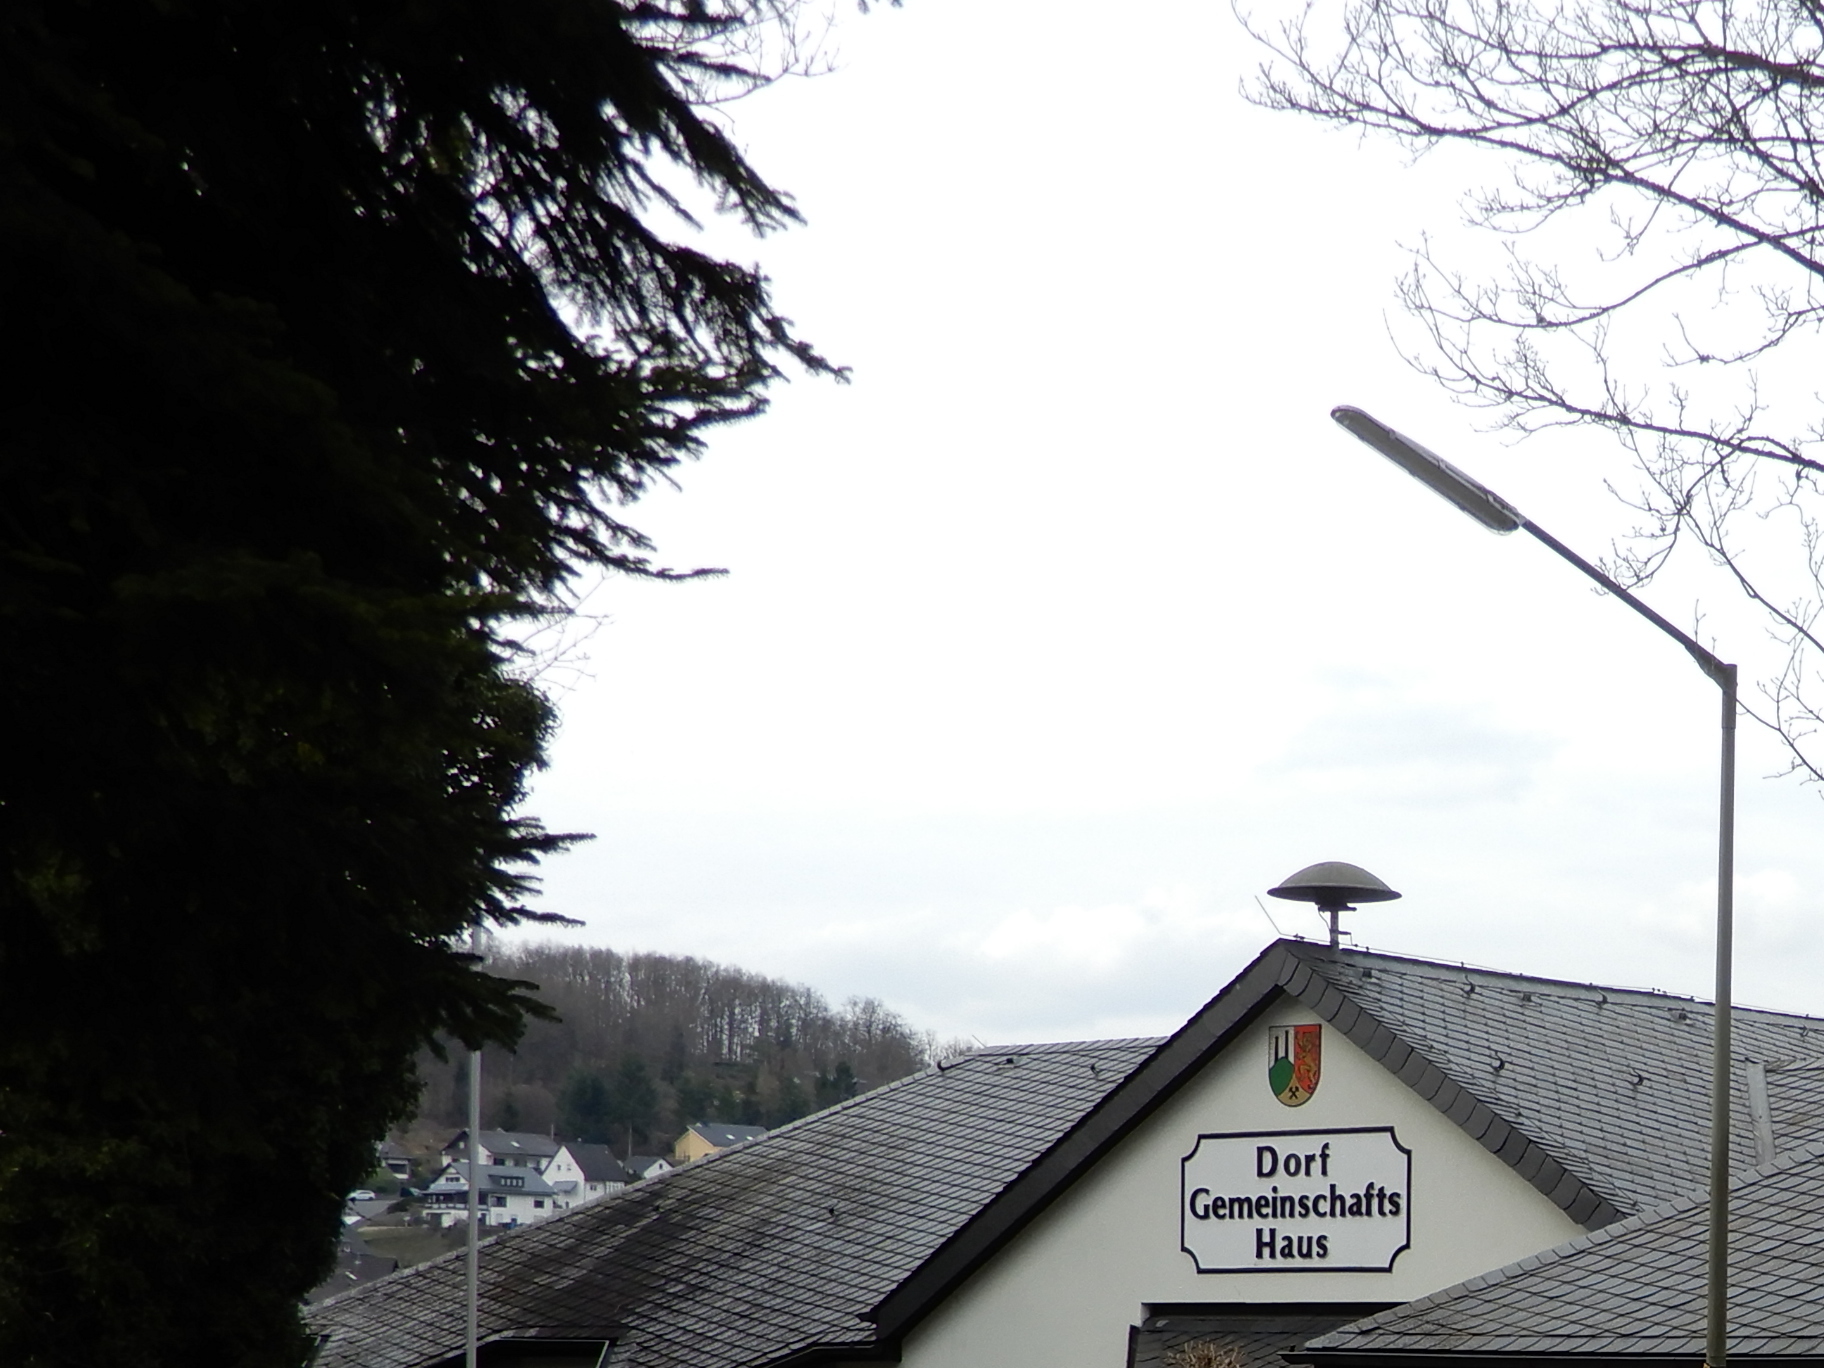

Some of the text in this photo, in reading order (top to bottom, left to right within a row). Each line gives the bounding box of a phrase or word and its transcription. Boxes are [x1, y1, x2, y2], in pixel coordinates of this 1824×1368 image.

[1256, 1142, 1331, 1178] Dorf
[1189, 1181, 1402, 1220] Gemeinschafts
[1255, 1228, 1329, 1259] Haus
